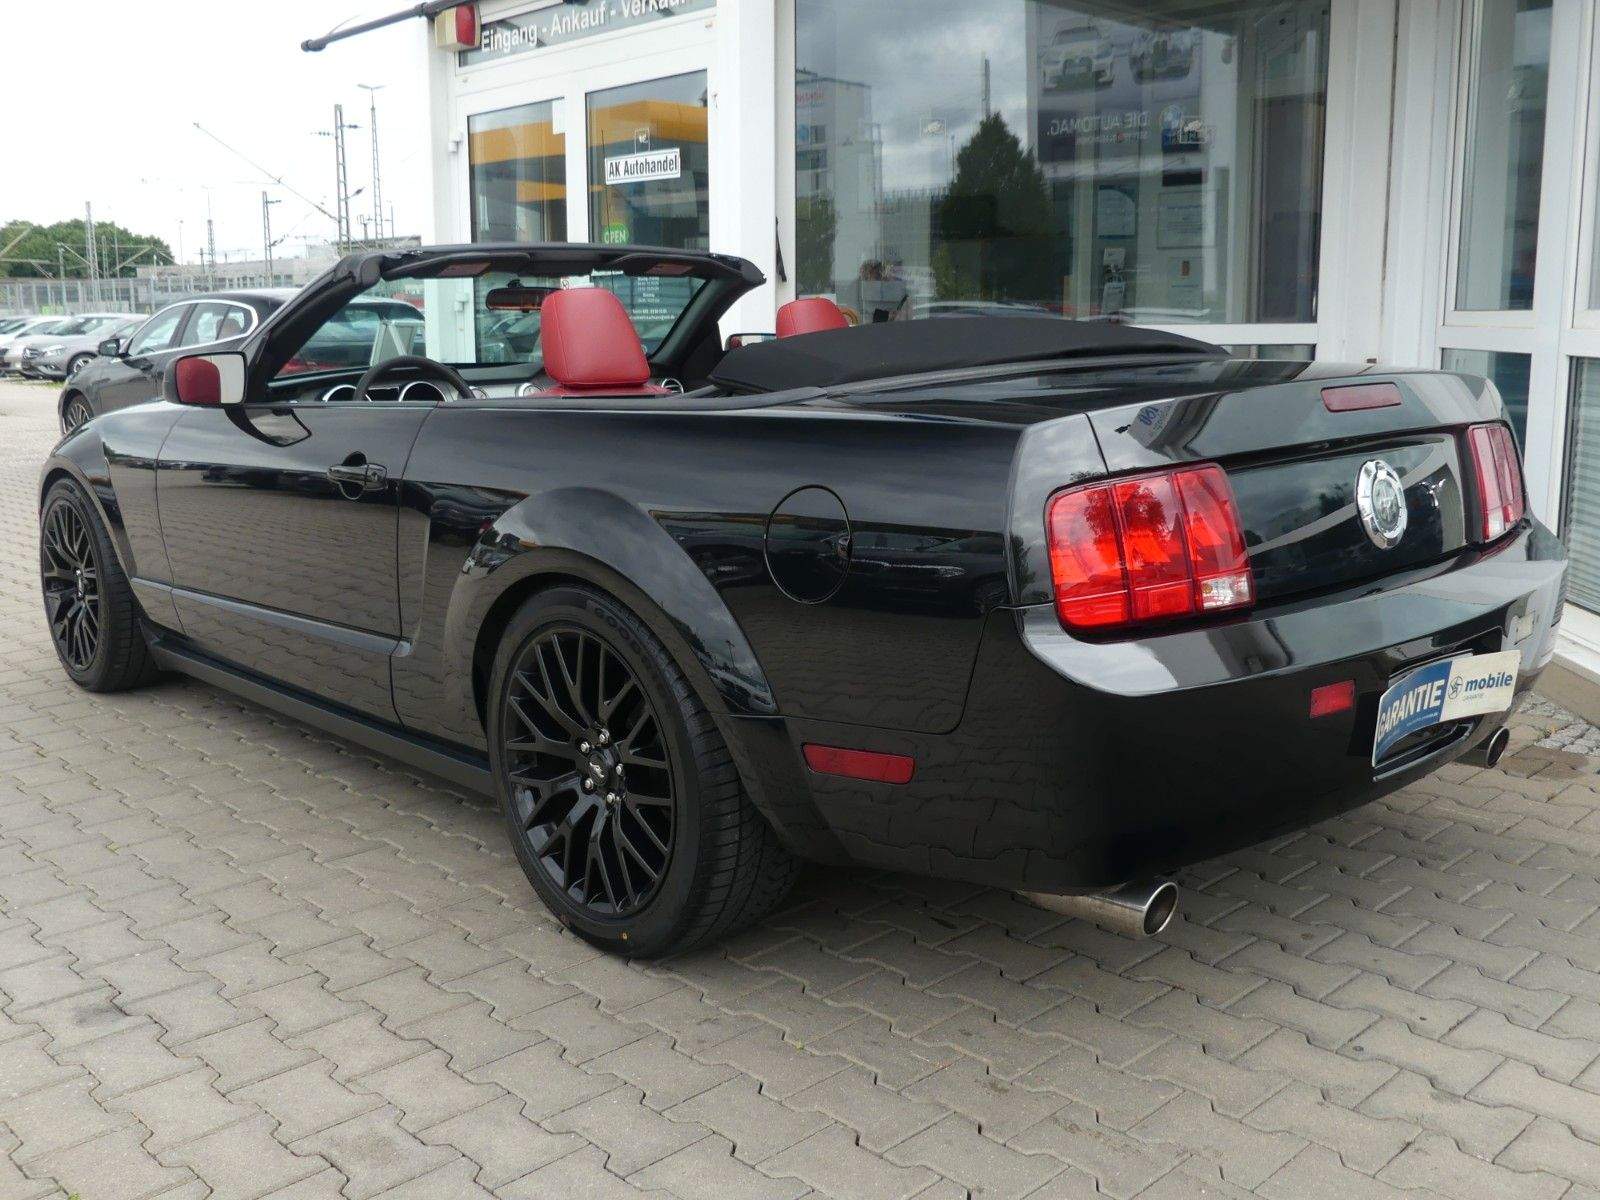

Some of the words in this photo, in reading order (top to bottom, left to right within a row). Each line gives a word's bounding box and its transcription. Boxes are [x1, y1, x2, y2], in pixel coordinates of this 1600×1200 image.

[481, 24, 538, 53] Eingang
[550, 1, 606, 36] Ankauf
[609, 161, 620, 177] AK
[624, 155, 677, 175] Autohandel
[604, 230, 626, 244] OPEN
[1465, 672, 1513, 691] mobile
[1378, 679, 1445, 743] GARANTIE
